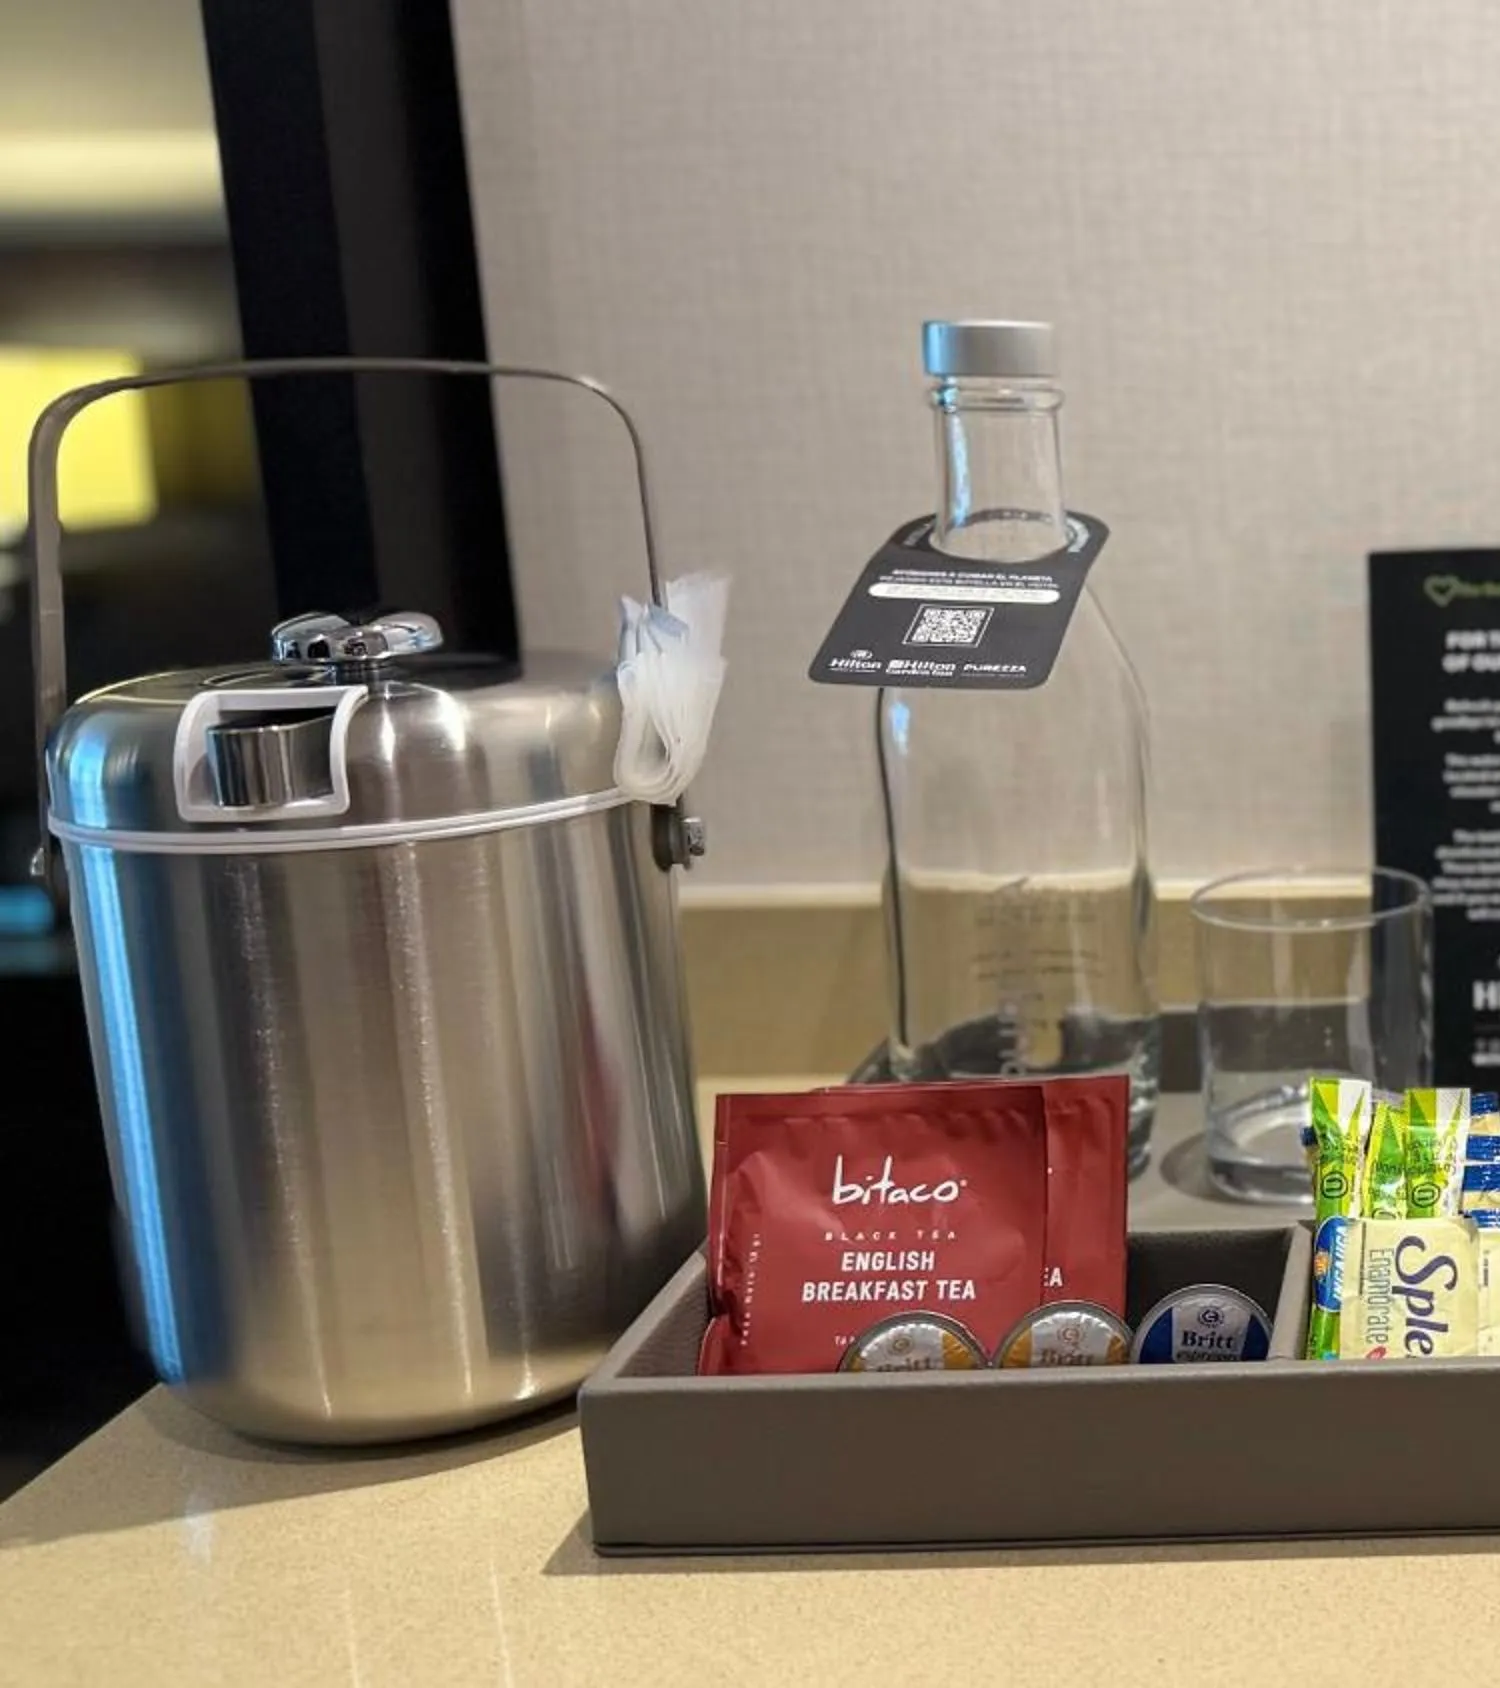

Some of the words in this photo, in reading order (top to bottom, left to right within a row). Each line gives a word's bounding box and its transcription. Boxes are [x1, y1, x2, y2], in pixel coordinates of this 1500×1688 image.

[828, 658, 881, 669] Hilton
[904, 659, 956, 671] Hilton
[831, 1154, 960, 1205] bitaco
[825, 1231, 897, 1241] BLACK
[917, 1229, 956, 1240] TEA
[841, 1251, 935, 1272] ENGLISH
[801, 1279, 929, 1302] BREAKFAST
[936, 1279, 977, 1300] TEA
[1392, 1235, 1458, 1359] Sple
[1182, 1329, 1234, 1349] Britt
